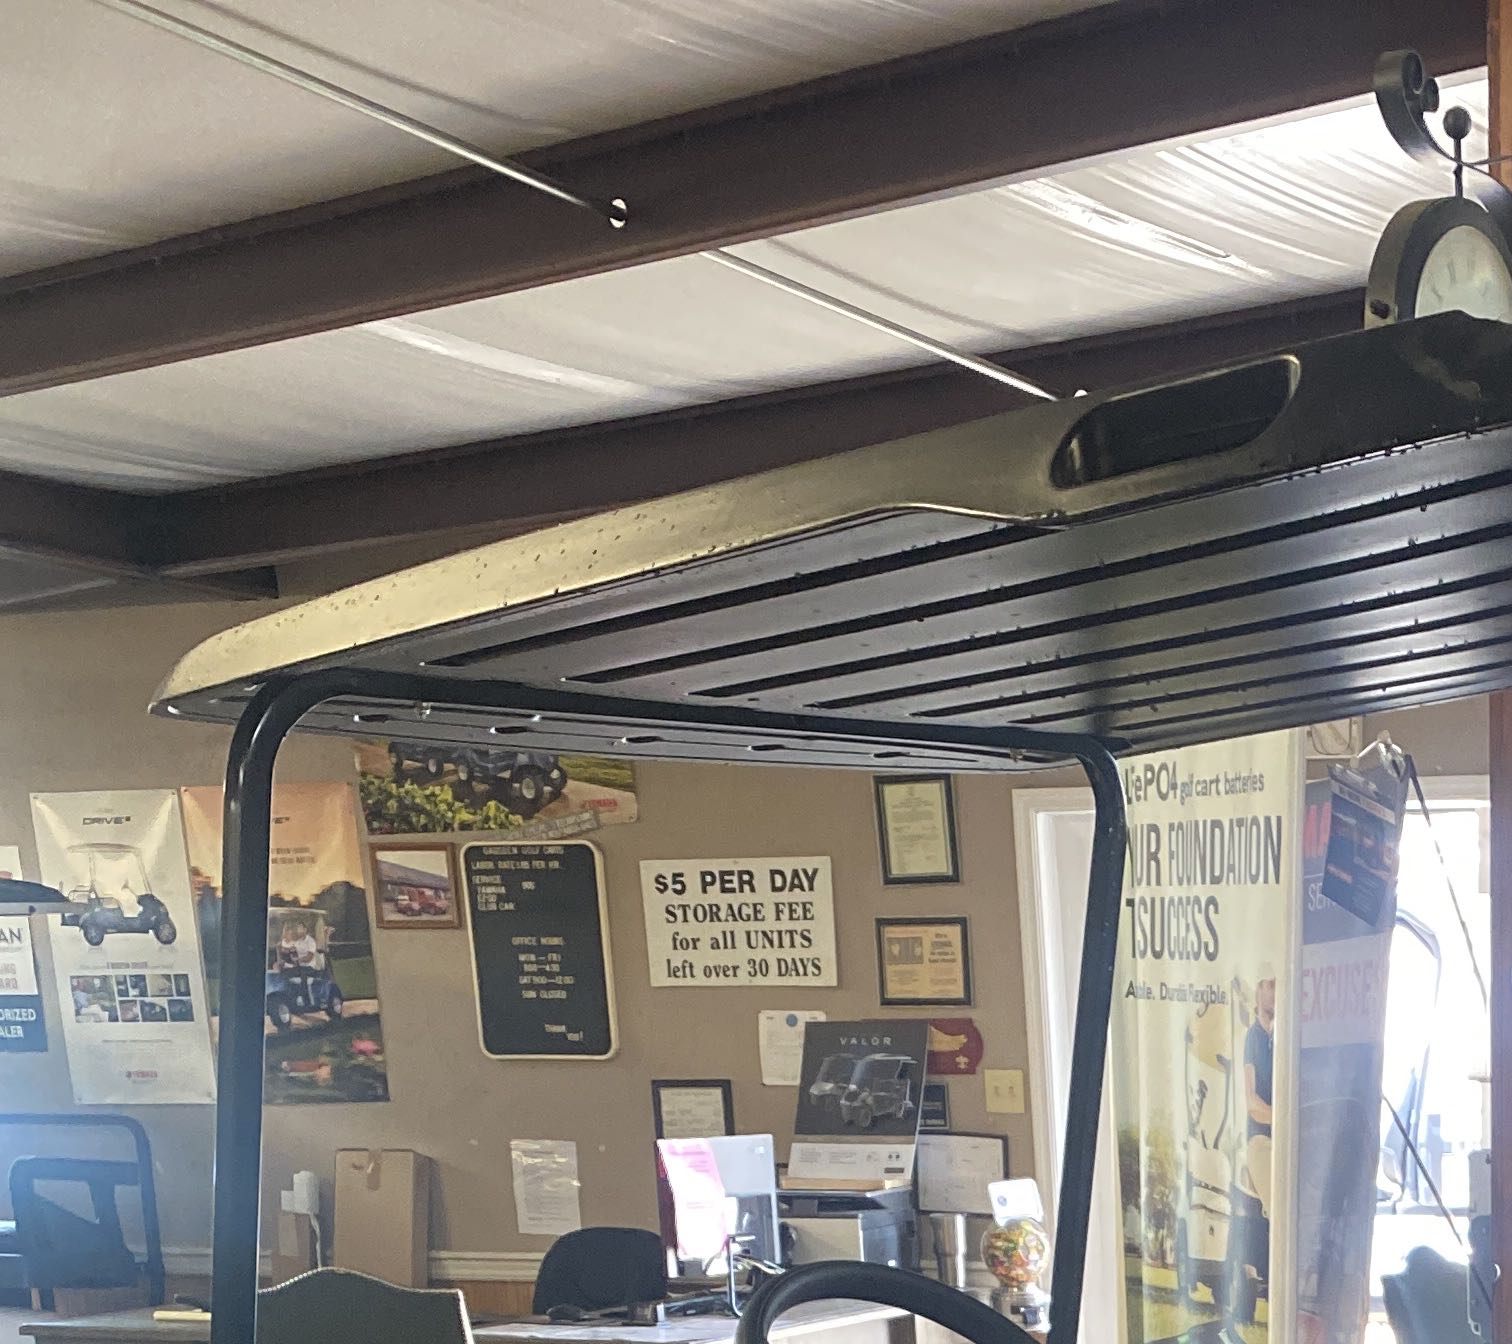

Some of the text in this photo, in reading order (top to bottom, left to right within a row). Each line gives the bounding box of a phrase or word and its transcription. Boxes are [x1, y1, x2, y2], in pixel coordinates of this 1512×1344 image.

[1195, 774, 1221, 796] cart
[1224, 767, 1265, 796] batteries
[1168, 815, 1282, 887] FOUNDATION
[654, 867, 819, 896] $5 PER DAY
[665, 902, 815, 924] STORAGE FEE
[672, 929, 812, 950] for all UNITS
[666, 957, 822, 978] left over 30 DAYS
[840, 1036, 893, 1047] VALOR
